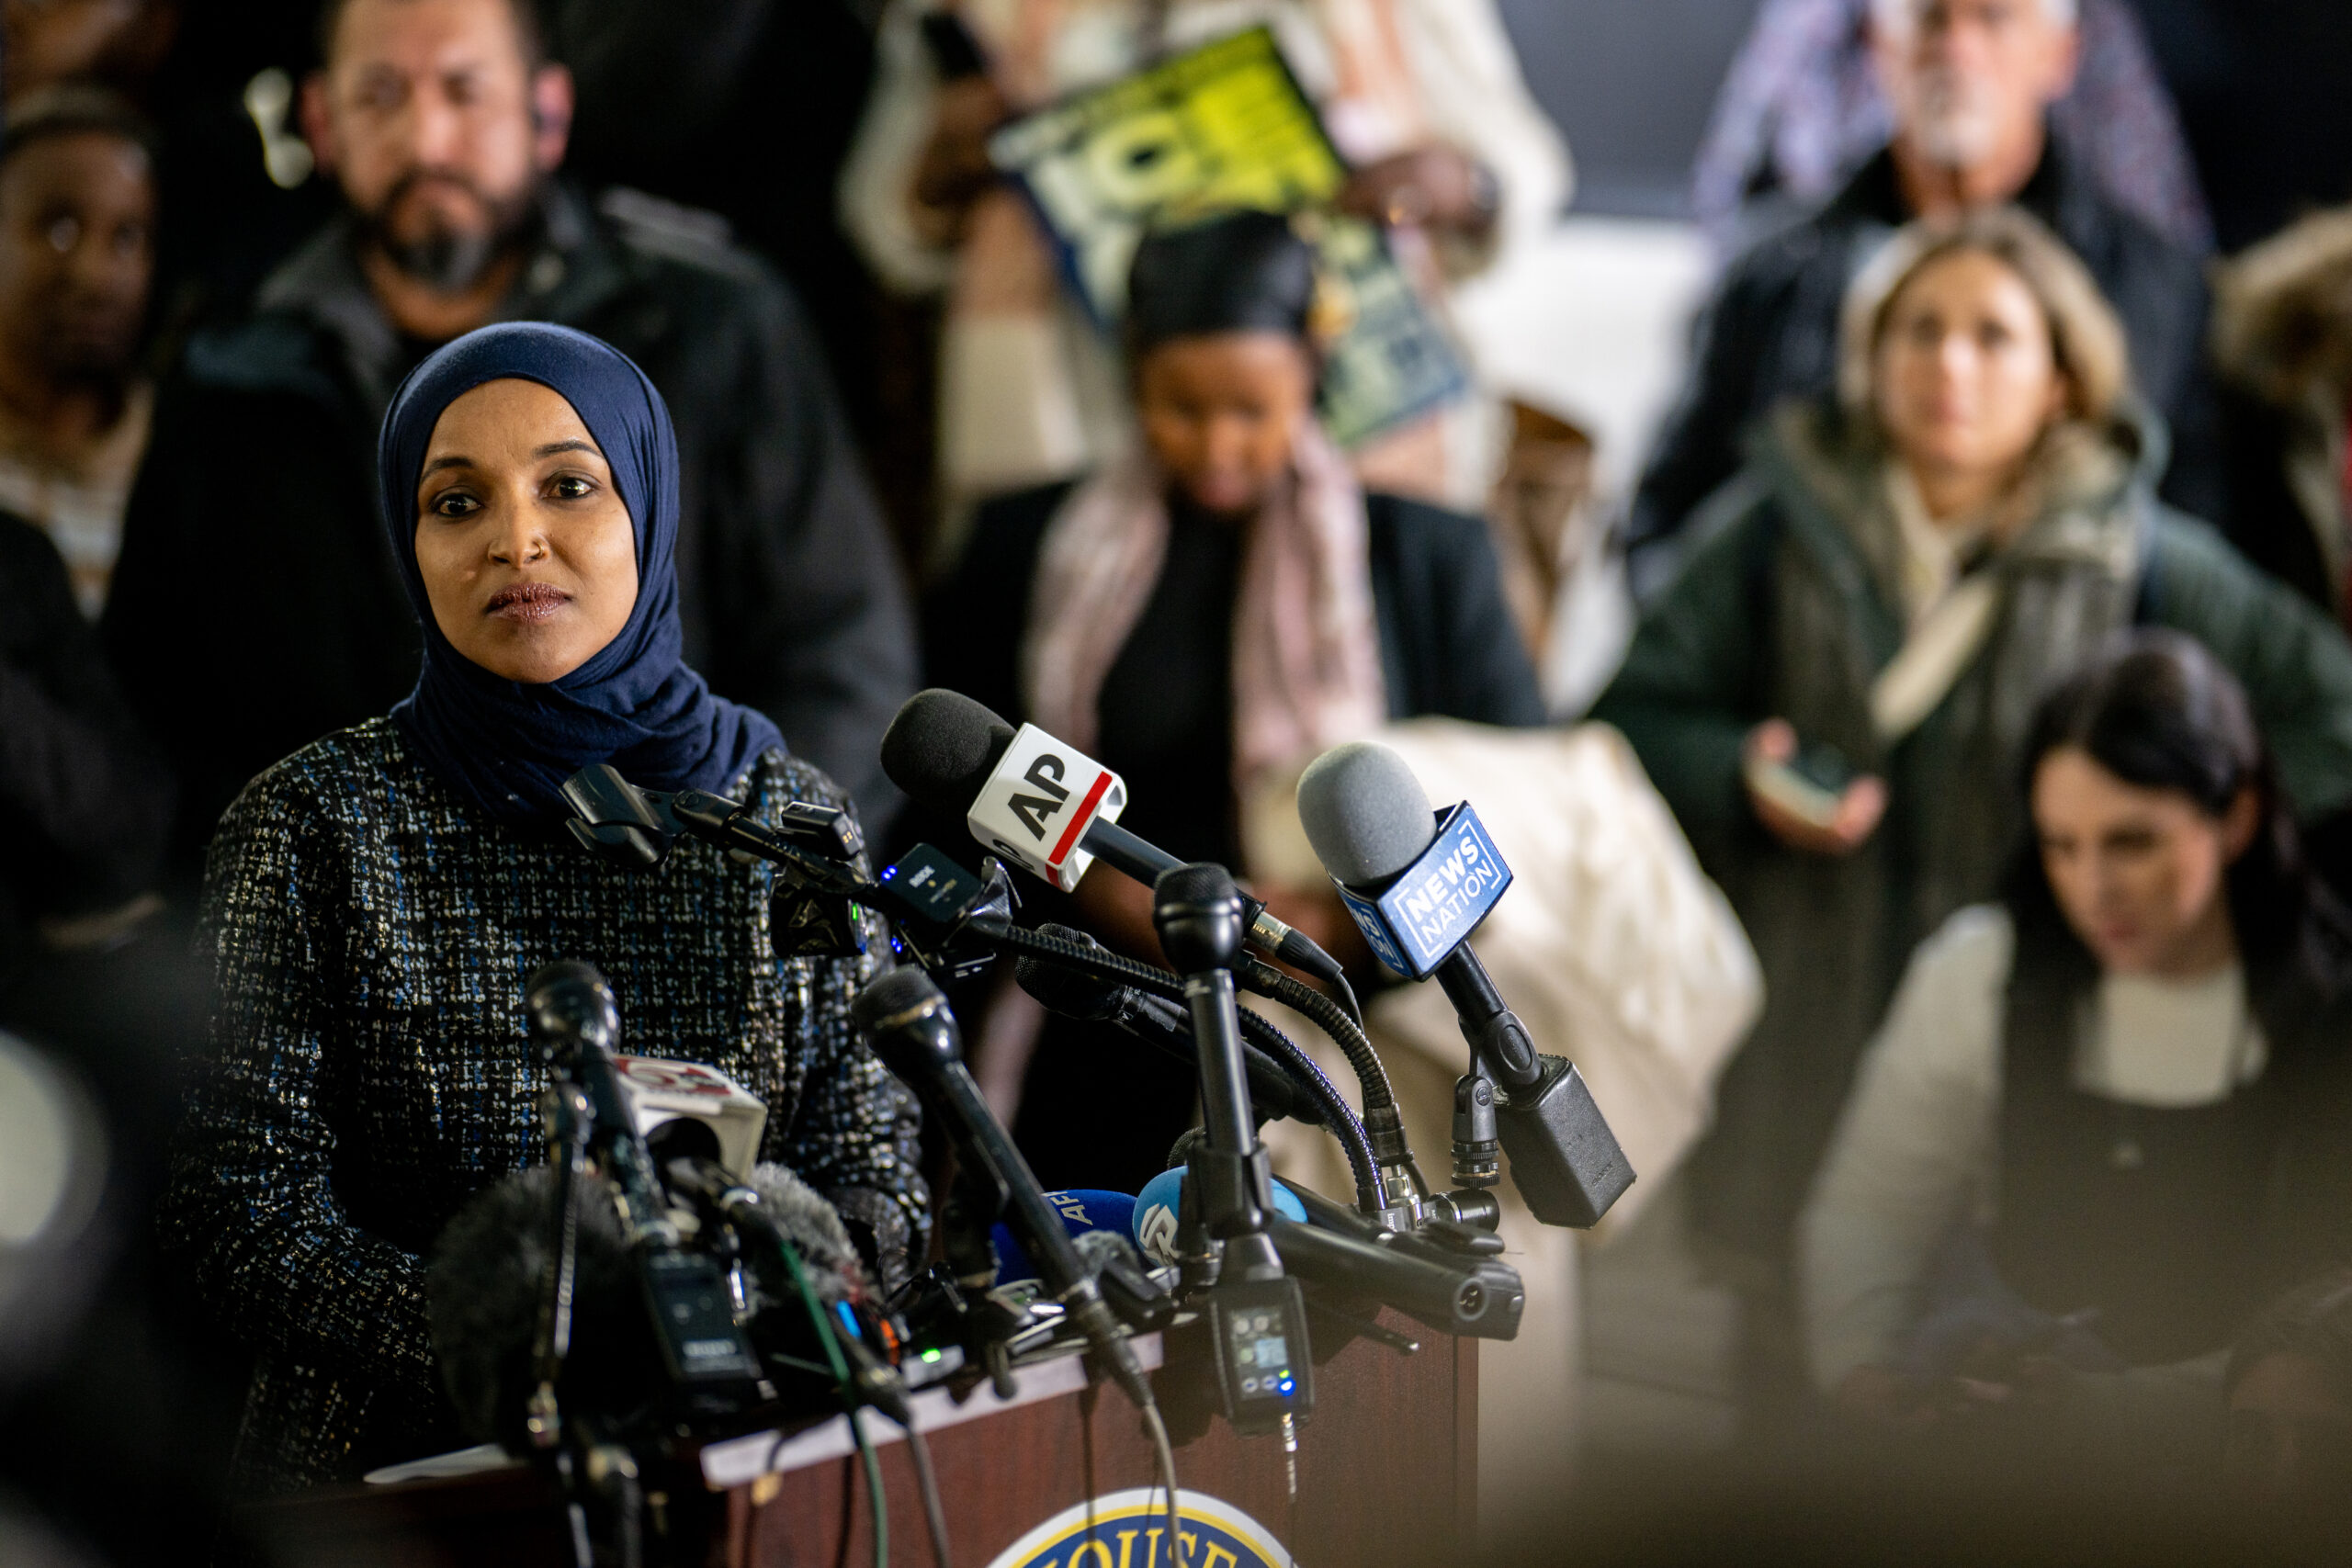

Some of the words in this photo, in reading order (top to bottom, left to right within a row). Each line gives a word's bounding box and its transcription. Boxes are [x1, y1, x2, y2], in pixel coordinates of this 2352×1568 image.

[1008, 754, 1070, 841] AP
[1405, 837, 1478, 922] NEWS
[1421, 860, 1493, 943] NATION
